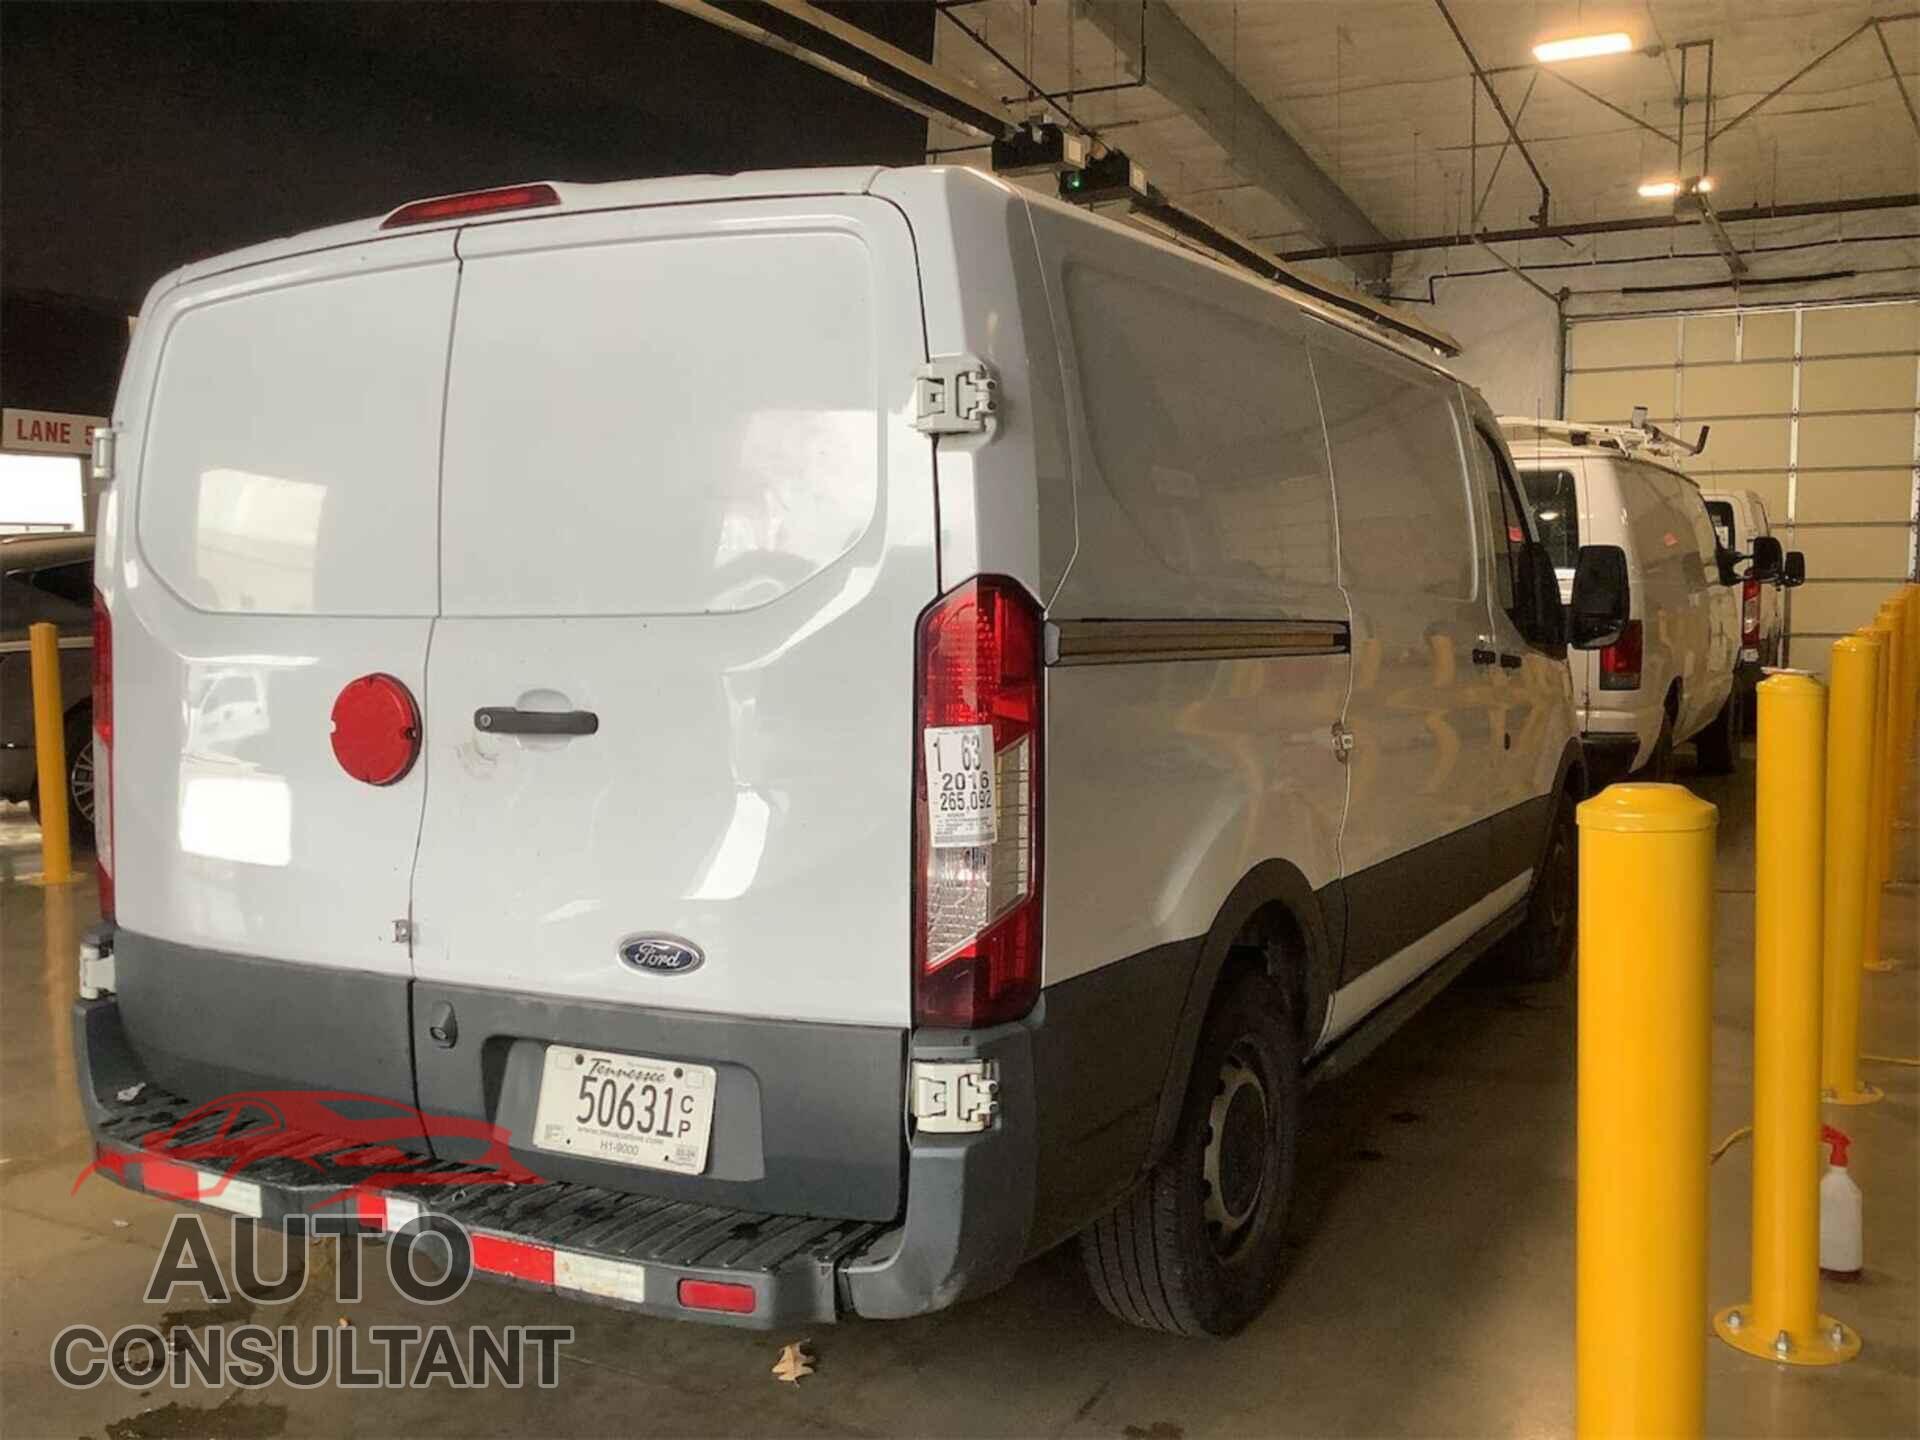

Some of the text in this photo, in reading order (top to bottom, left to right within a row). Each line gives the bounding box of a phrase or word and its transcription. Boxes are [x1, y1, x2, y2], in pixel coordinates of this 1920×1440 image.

[16, 418, 71, 444] LANE
[941, 771, 990, 792] 2016
[634, 943, 681, 967] Ford
[589, 1057, 666, 1082] Tennessee
[576, 1075, 674, 1138] 50631
